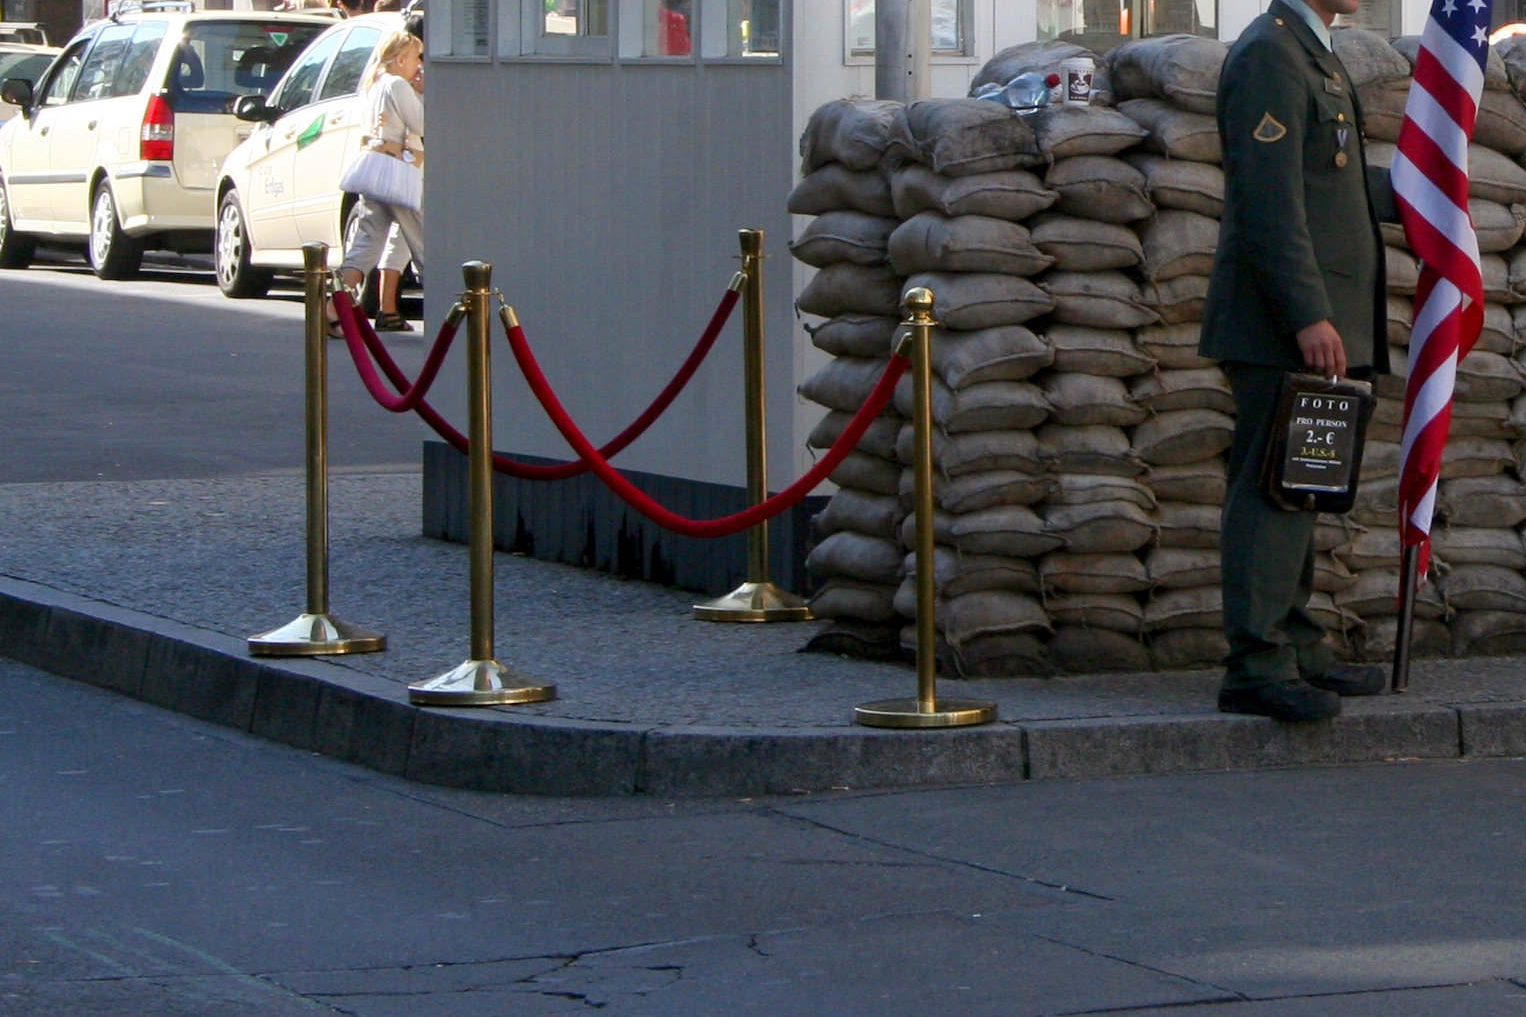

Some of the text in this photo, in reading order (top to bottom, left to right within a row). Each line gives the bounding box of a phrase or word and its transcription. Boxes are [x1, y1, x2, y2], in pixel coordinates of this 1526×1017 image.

[1300, 397, 1349, 411] FOTO
[1296, 416, 1347, 428] PRO PERSON
[1325, 431, 1335, 445] €
